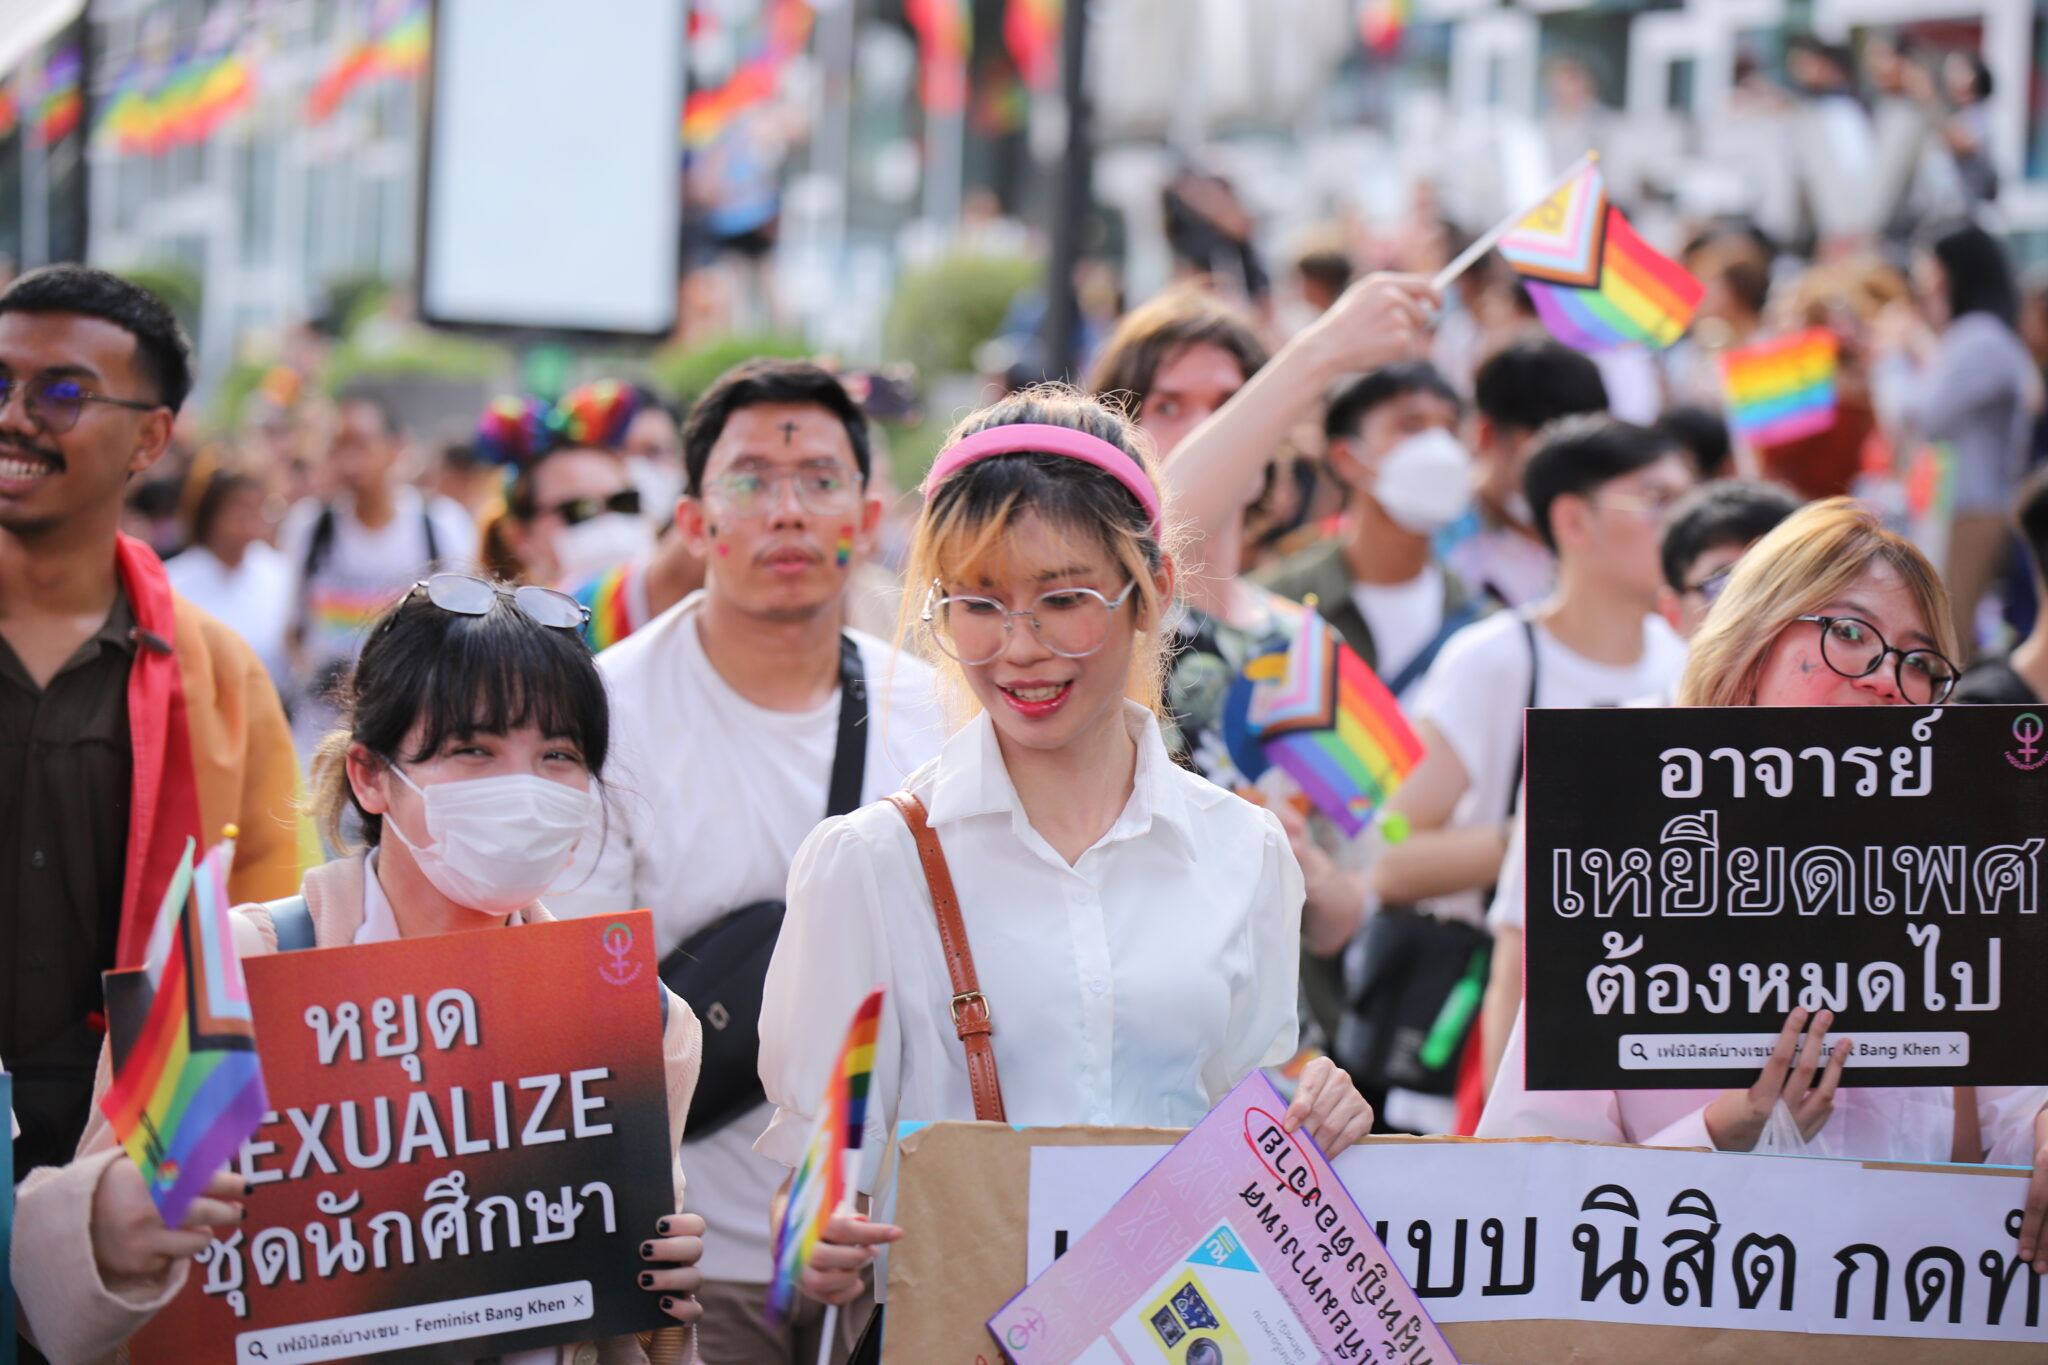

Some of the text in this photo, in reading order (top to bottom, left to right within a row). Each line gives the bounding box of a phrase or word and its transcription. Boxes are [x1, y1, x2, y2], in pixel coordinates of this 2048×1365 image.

[1658, 708, 1943, 799] อาจารย์
[1552, 809, 2046, 918] เหยียดเพศ
[1586, 922, 2001, 1015] ต้องหมดไป
[304, 987, 479, 1082] หยุด
[1859, 1043, 1898, 1060] Bang
[1902, 1043, 1941, 1056] Khen
[222, 1067, 613, 1184] EXUALIZE
[194, 1170, 617, 1317] ชุดนักศึกษา
[1205, 1238, 1230, 1265] KU
[1572, 1183, 1798, 1312] นิสิต
[415, 1311, 481, 1333] Feminist
[485, 1306, 524, 1322] Bang
[527, 1298, 566, 1316] Khen
